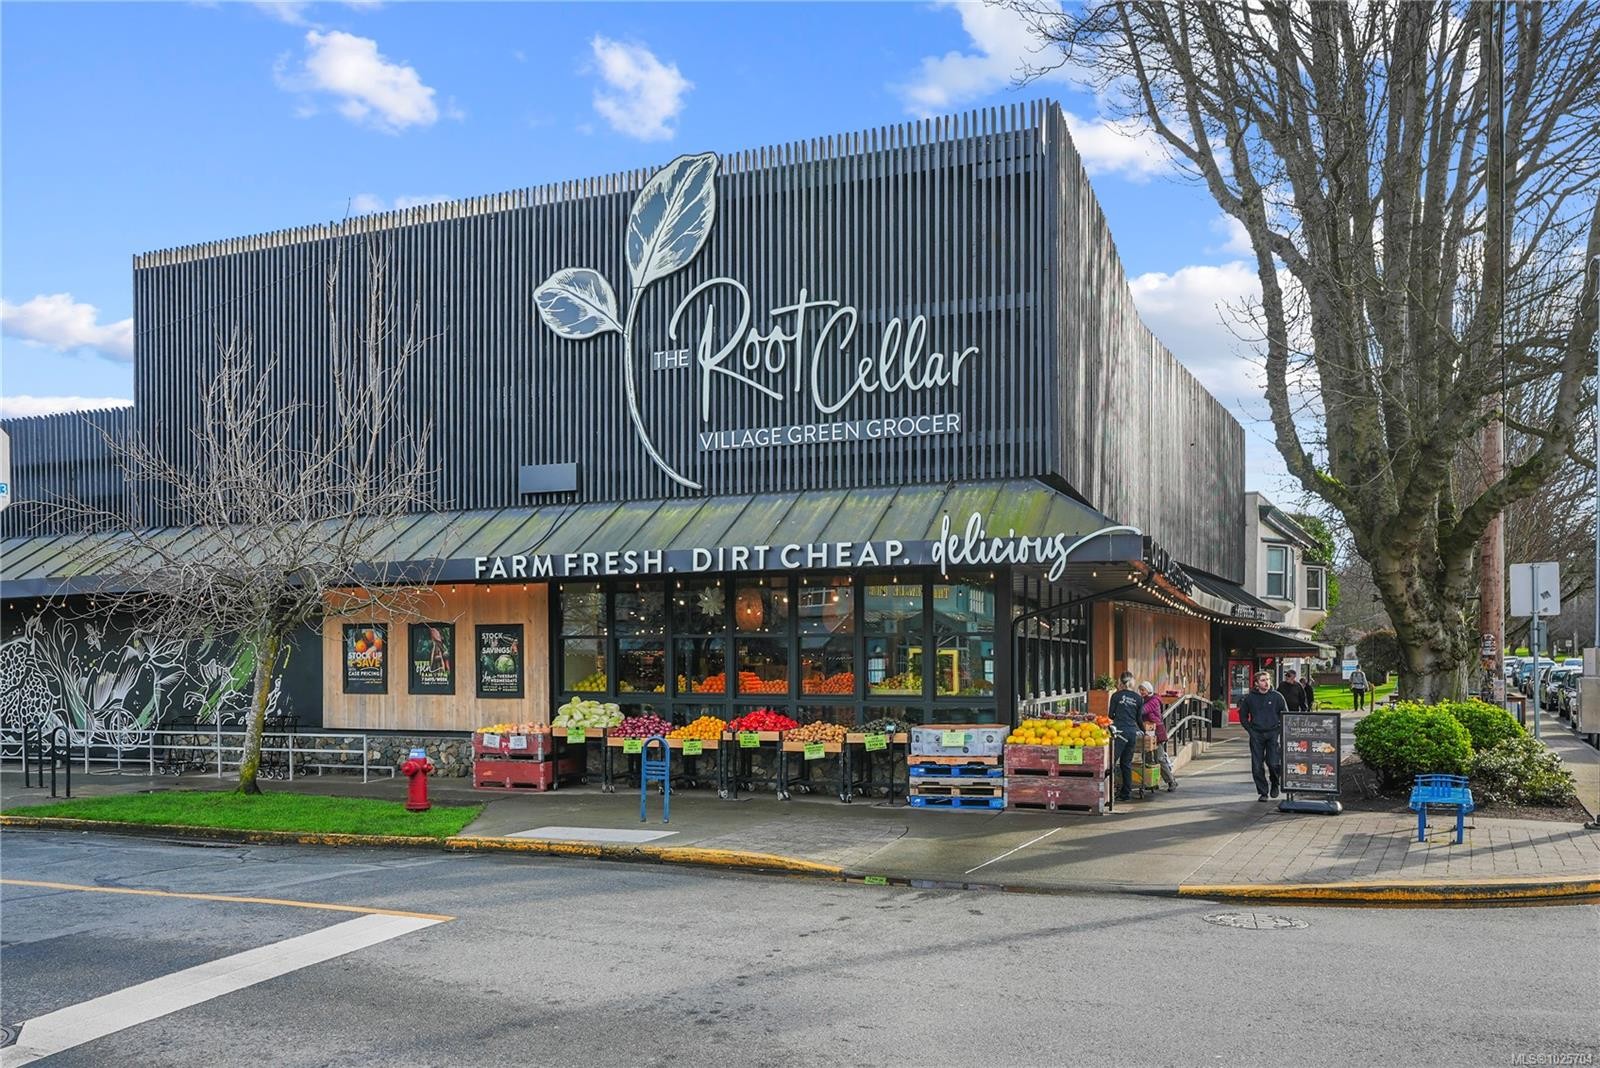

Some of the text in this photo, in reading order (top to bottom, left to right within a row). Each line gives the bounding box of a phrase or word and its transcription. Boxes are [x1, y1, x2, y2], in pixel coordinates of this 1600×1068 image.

[654, 277, 980, 423] THE Root Cellar
[700, 413, 960, 450] VILLAGE GREEN GROCER
[474, 554, 553, 579] FARM
[564, 549, 676, 576] FRESH.
[692, 545, 770, 572] DIRT
[780, 540, 910, 569] CHEAP.
[932, 511, 1143, 582] delicious
[481, 632, 503, 640] STOCK
[348, 651, 383, 660] STOCK UP
[357, 659, 381, 668] SAVE
